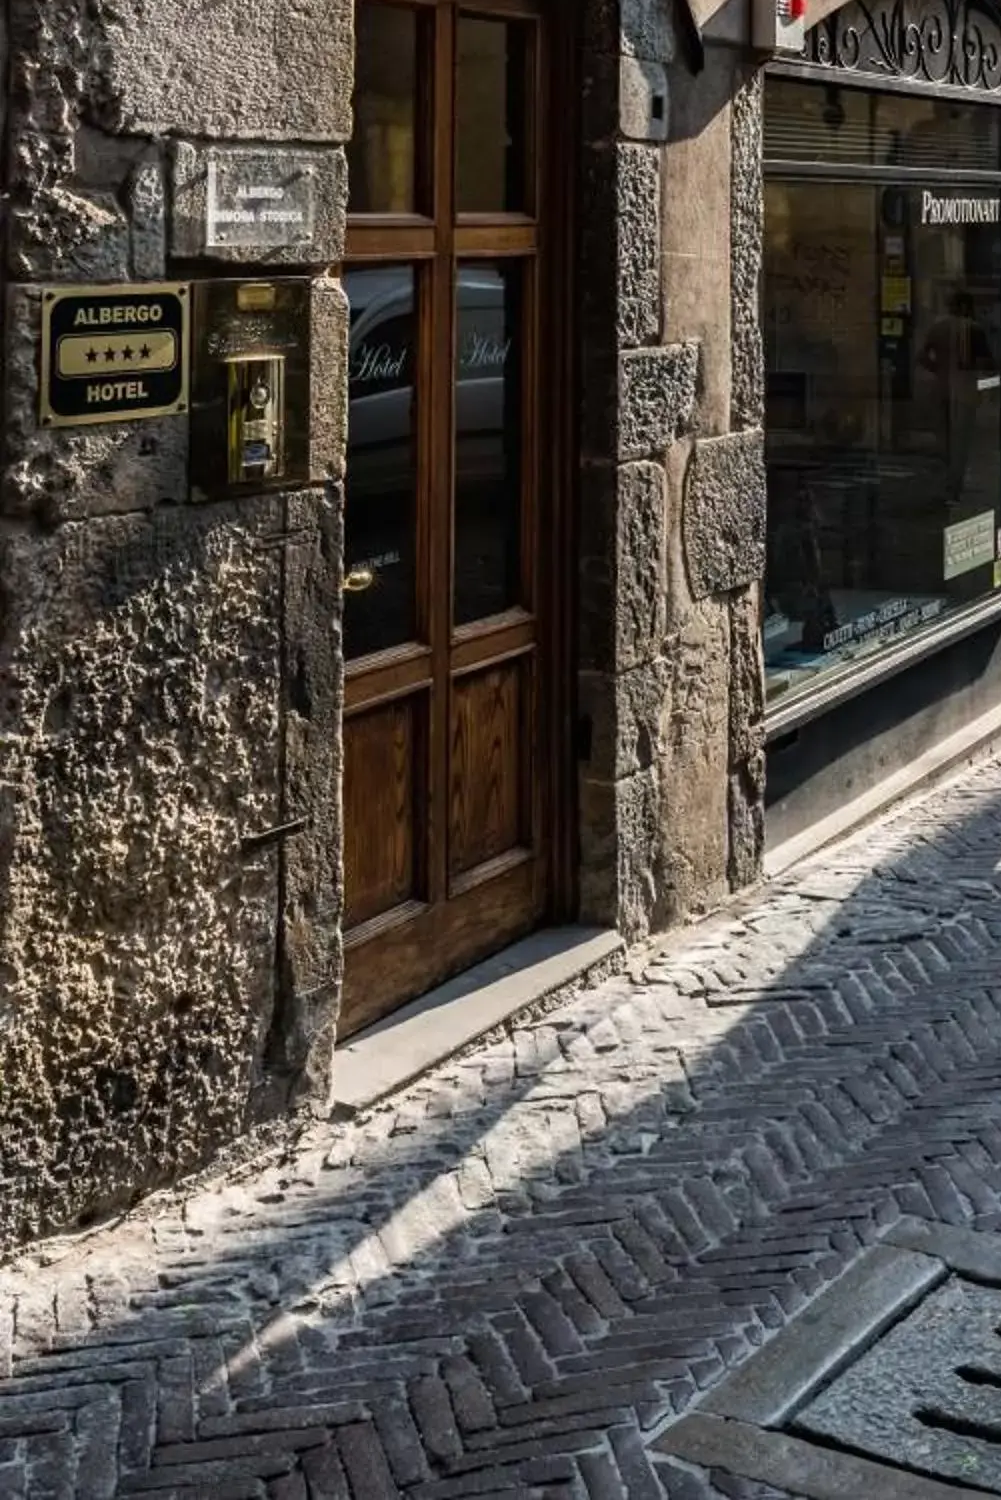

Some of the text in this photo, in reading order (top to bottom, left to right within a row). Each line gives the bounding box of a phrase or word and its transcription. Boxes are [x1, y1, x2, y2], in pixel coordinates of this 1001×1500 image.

[74, 304, 163, 325] ALBERGO
[349, 342, 407, 381] Hotel
[460, 329, 512, 368] Hotel
[86, 382, 149, 404] HOTEL
